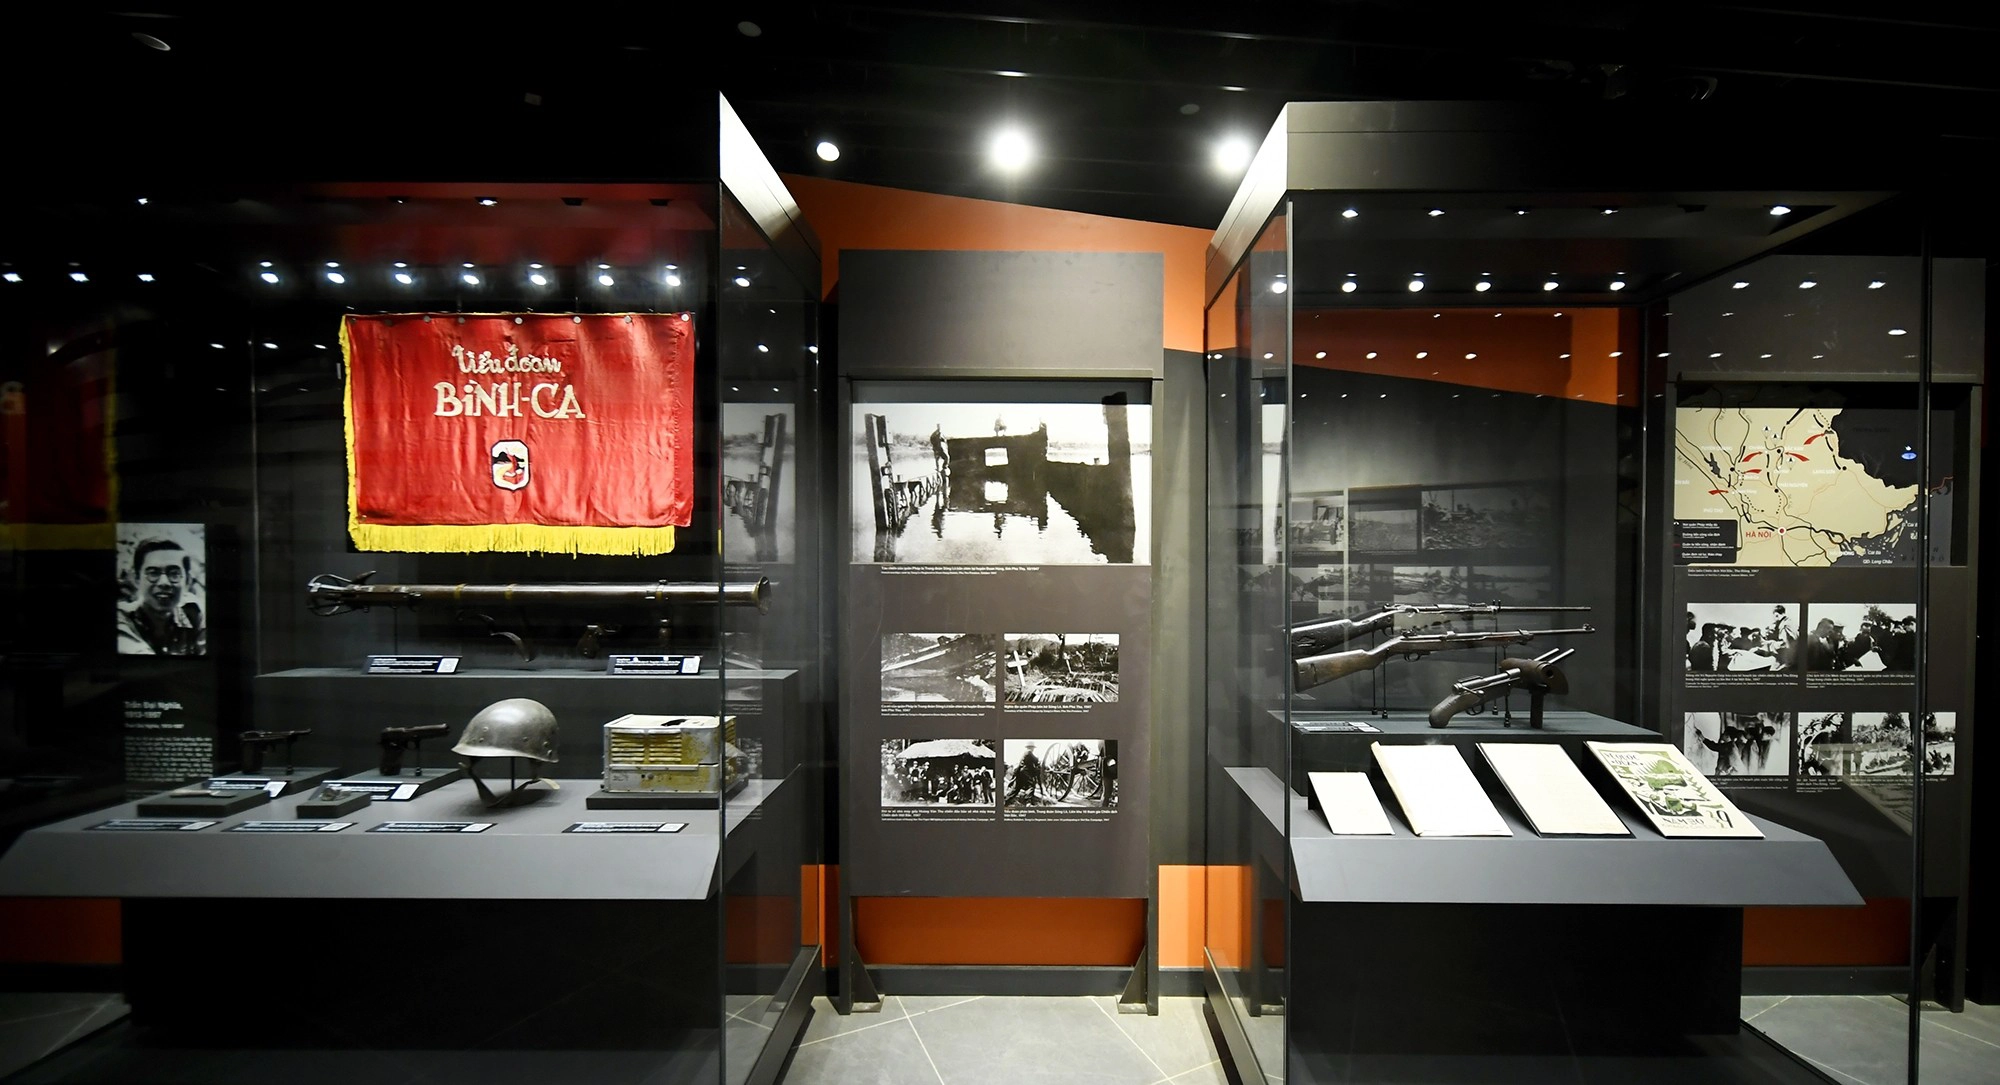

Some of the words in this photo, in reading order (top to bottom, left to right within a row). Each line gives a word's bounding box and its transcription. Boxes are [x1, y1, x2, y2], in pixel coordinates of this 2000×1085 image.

[505, 344, 561, 373] đoàn
[1745, 531, 1757, 539] HÀ
[1758, 531, 1772, 539] NỘI
